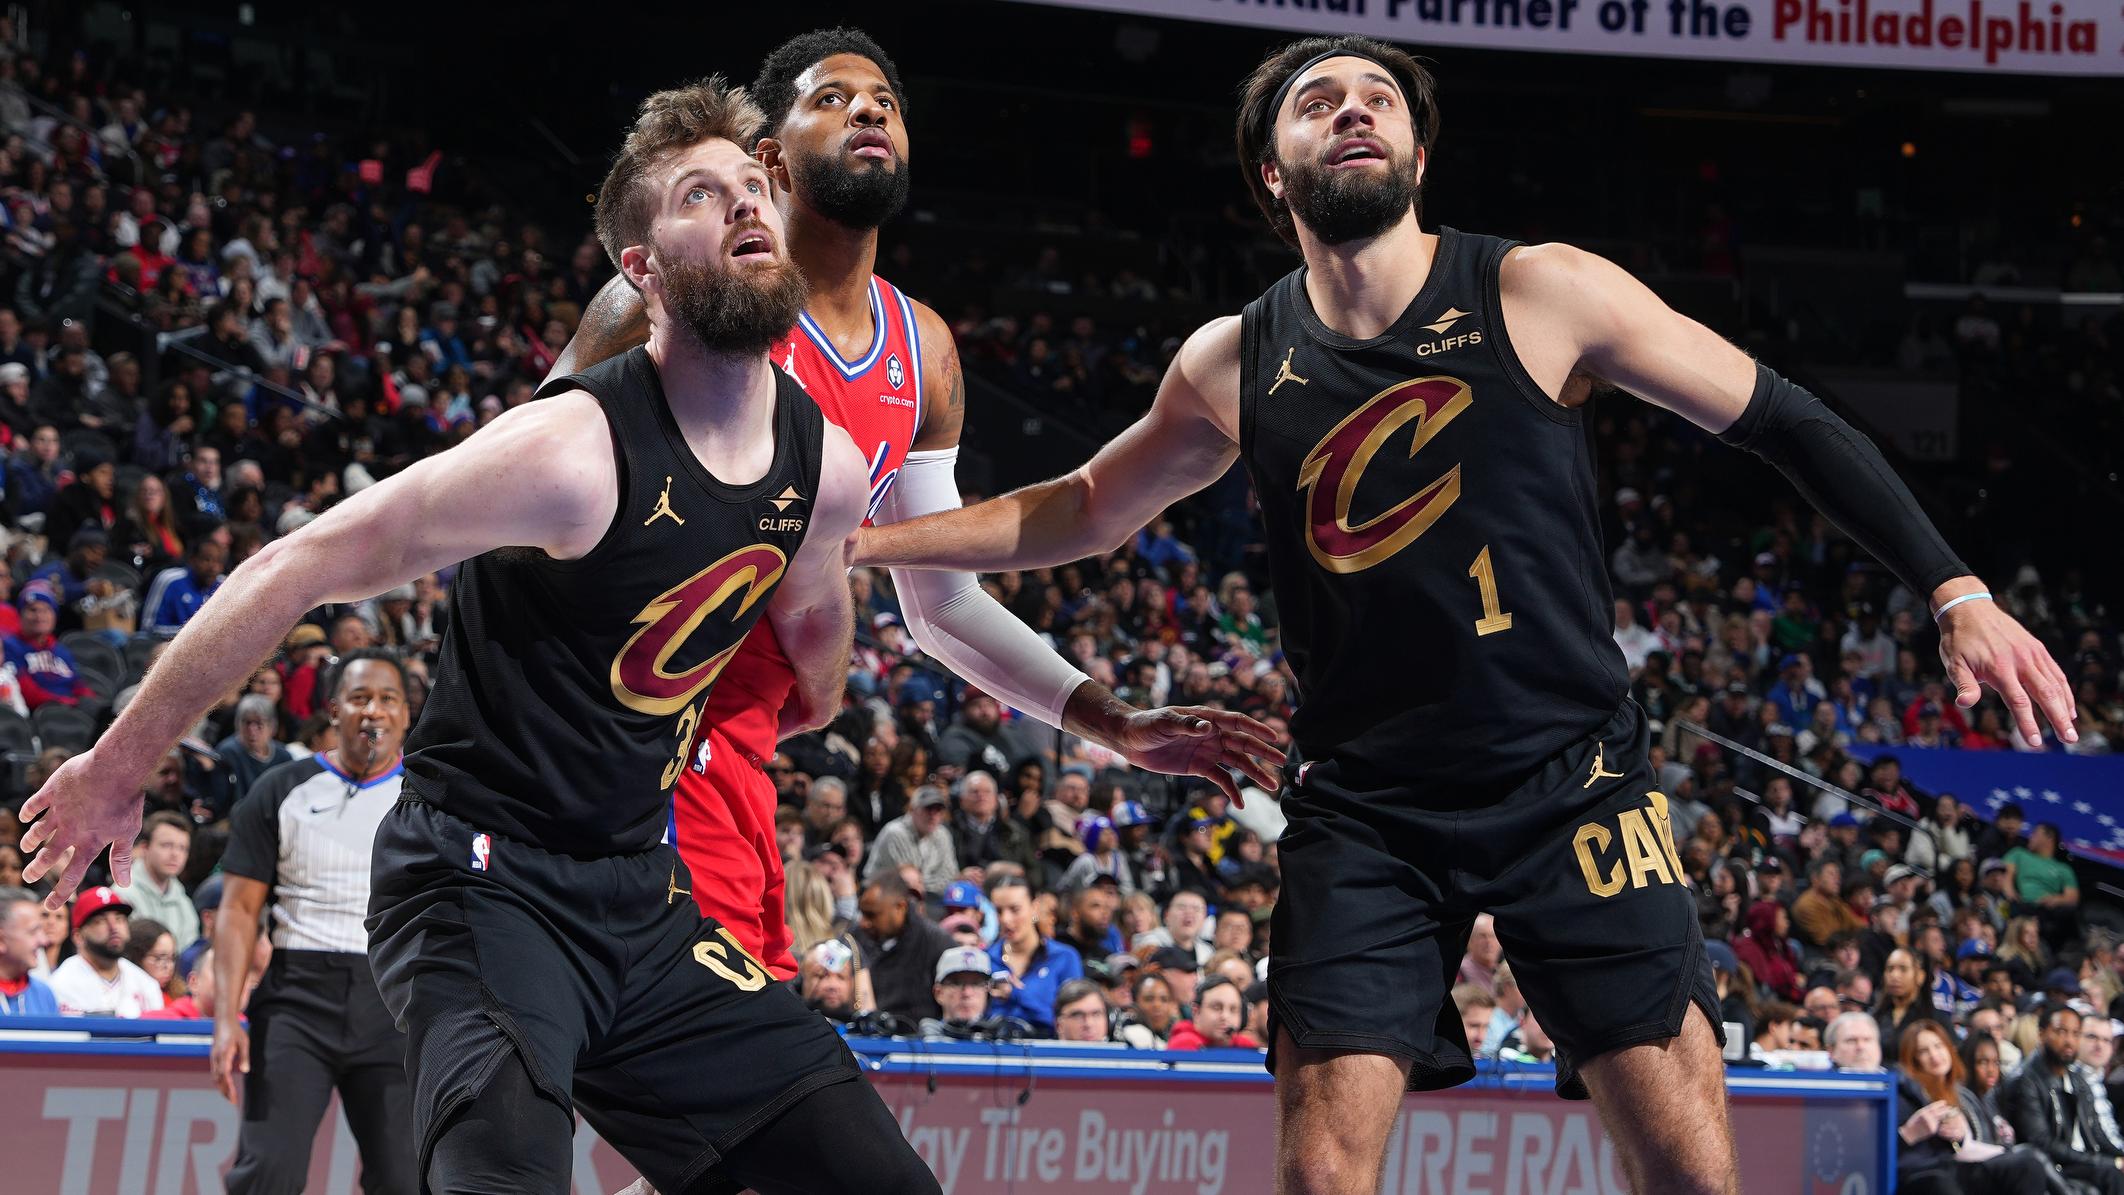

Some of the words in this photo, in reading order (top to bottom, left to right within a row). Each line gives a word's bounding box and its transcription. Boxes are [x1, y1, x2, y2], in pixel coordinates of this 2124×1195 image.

[1598, 0, 1649, 34] of
[1669, 0, 1751, 39] the
[1772, 0, 2097, 66] Philadelphia
[1416, 331, 1483, 357] CLIFFS
[879, 394, 914, 409] crypto.com
[758, 517, 804, 533] CLIFFS
[1469, 544, 1512, 636] 1
[661, 696, 709, 790] 3
[1572, 791, 1688, 898] CAV
[42, 1087, 243, 1195] TIR
[980, 1107, 1066, 1182] Tire
[1074, 1108, 1229, 1195] Buying
[1384, 1111, 1498, 1195] IRE
